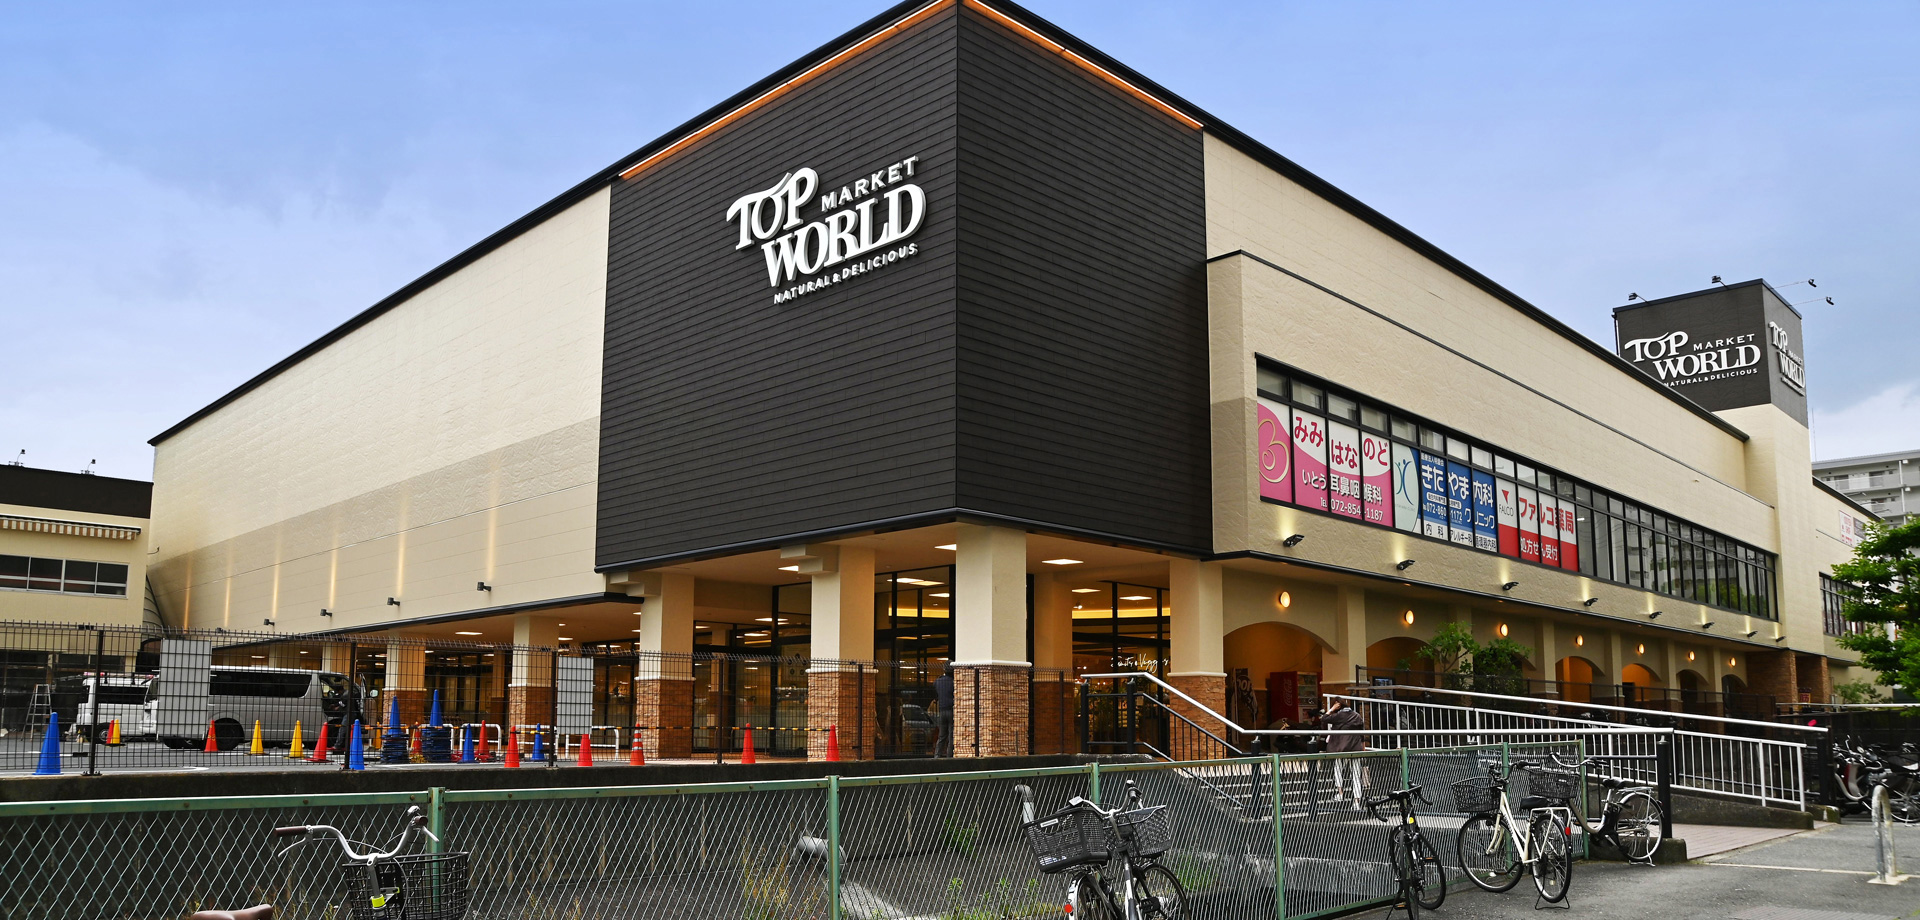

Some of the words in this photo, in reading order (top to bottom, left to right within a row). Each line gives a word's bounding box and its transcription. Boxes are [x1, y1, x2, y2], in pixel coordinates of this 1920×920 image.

[726, 167, 819, 250] TOP
[821, 155, 919, 212] MARKET
[761, 184, 927, 287] WORLD
[1624, 331, 1688, 363] TOP
[1693, 333, 1755, 351] MARKET
[1768, 321, 1788, 353] TOP
[1653, 345, 1761, 380] WORLD
[1778, 351, 1806, 388] WORLD
[1294, 416, 1324, 447] みみ
[1331, 439, 1358, 469] はな
[1363, 437, 1388, 466] のど
[1427, 502, 1463, 521] 072-8601172
[1499, 503, 1514, 517] FALCO
[1519, 497, 1575, 534] ファルコ薬局
